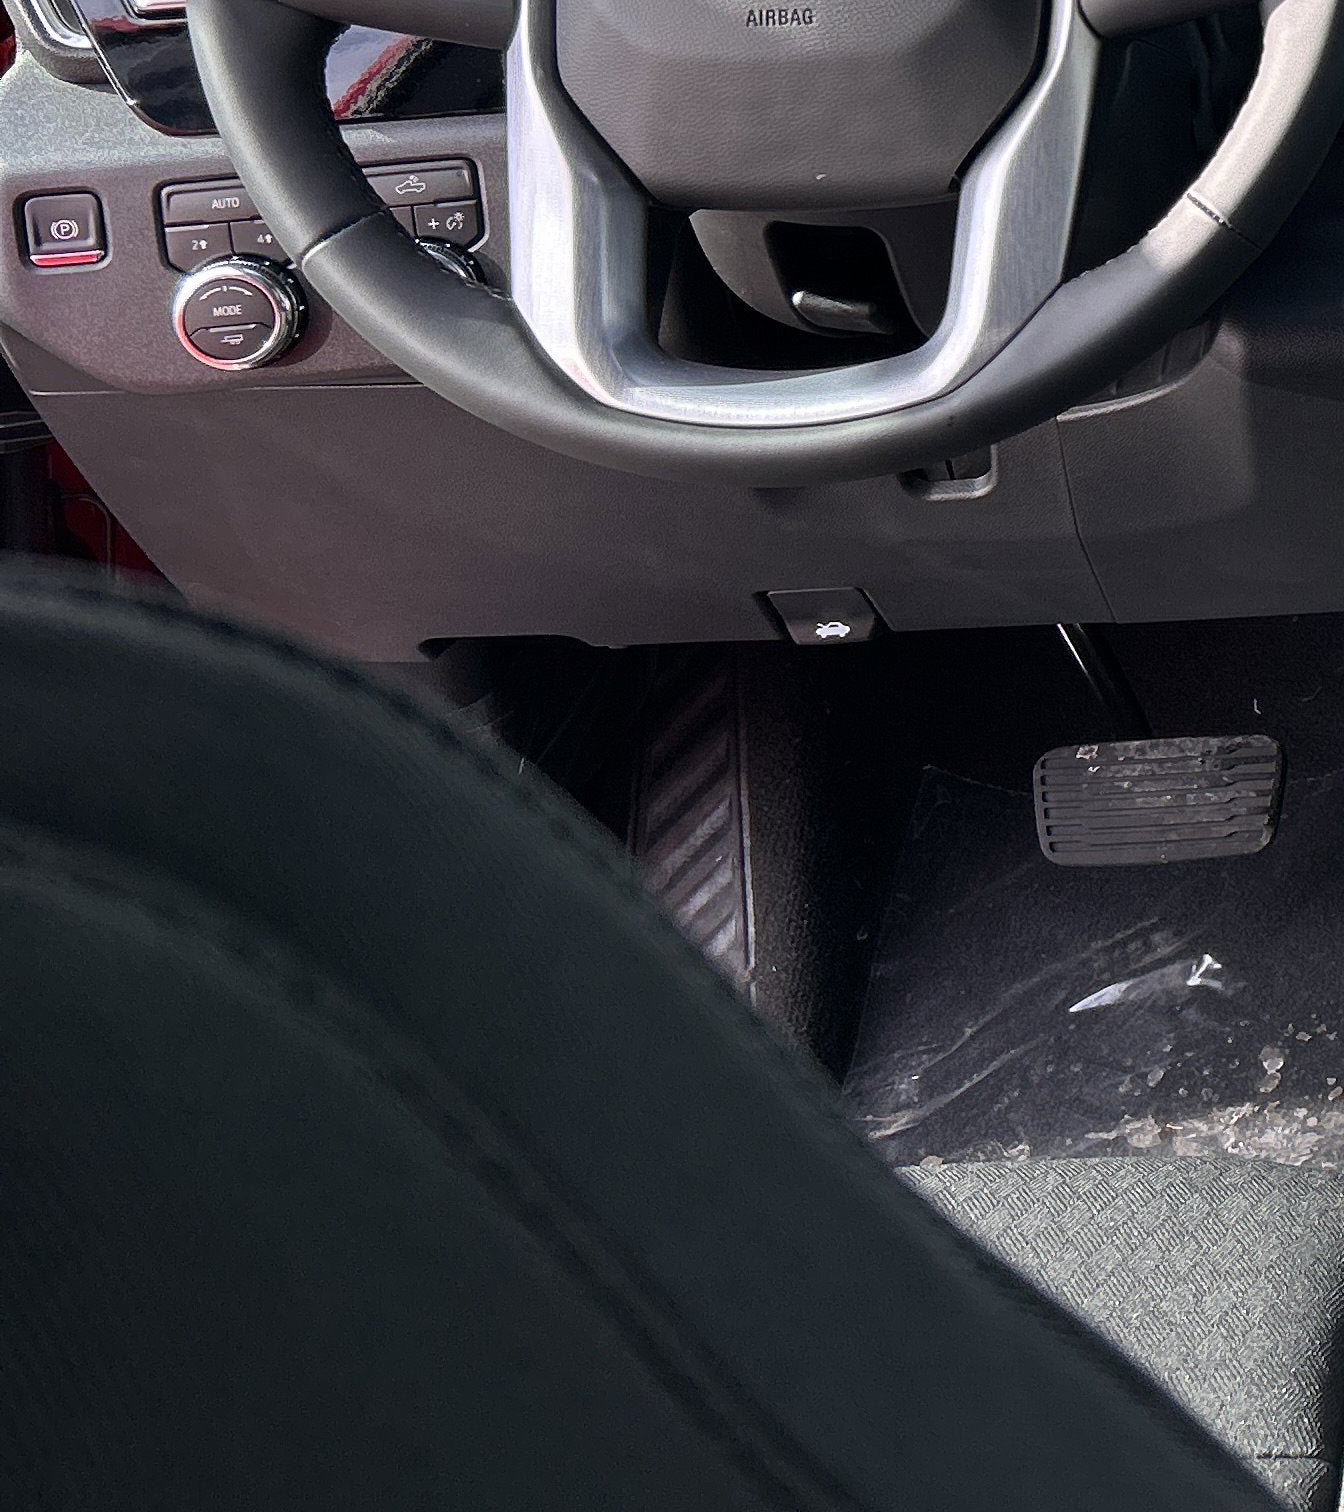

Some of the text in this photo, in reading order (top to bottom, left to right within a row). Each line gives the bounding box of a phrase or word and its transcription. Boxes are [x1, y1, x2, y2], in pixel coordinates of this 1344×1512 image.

[745, 8, 814, 28] AIRBAG
[211, 197, 240, 209] AUTO
[212, 304, 242, 317] MODE
